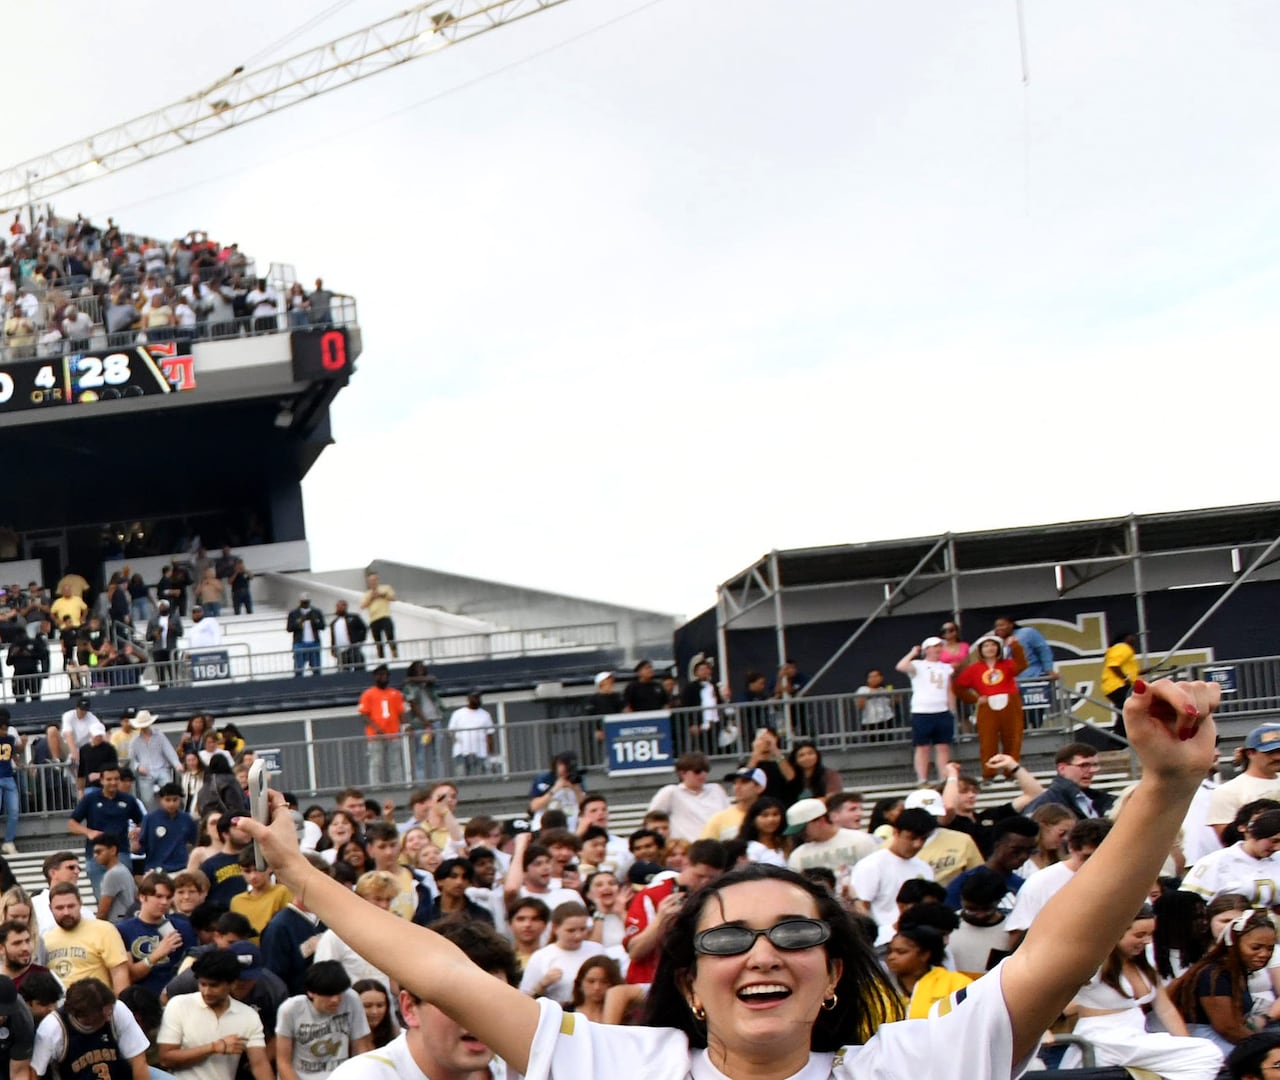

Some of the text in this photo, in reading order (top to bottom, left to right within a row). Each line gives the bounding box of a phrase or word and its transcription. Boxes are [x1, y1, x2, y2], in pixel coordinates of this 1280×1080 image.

[35, 366, 56, 389] 4
[77, 354, 131, 389] 28
[192, 664, 228, 680] 118U
[612, 739, 670, 763] 118L
